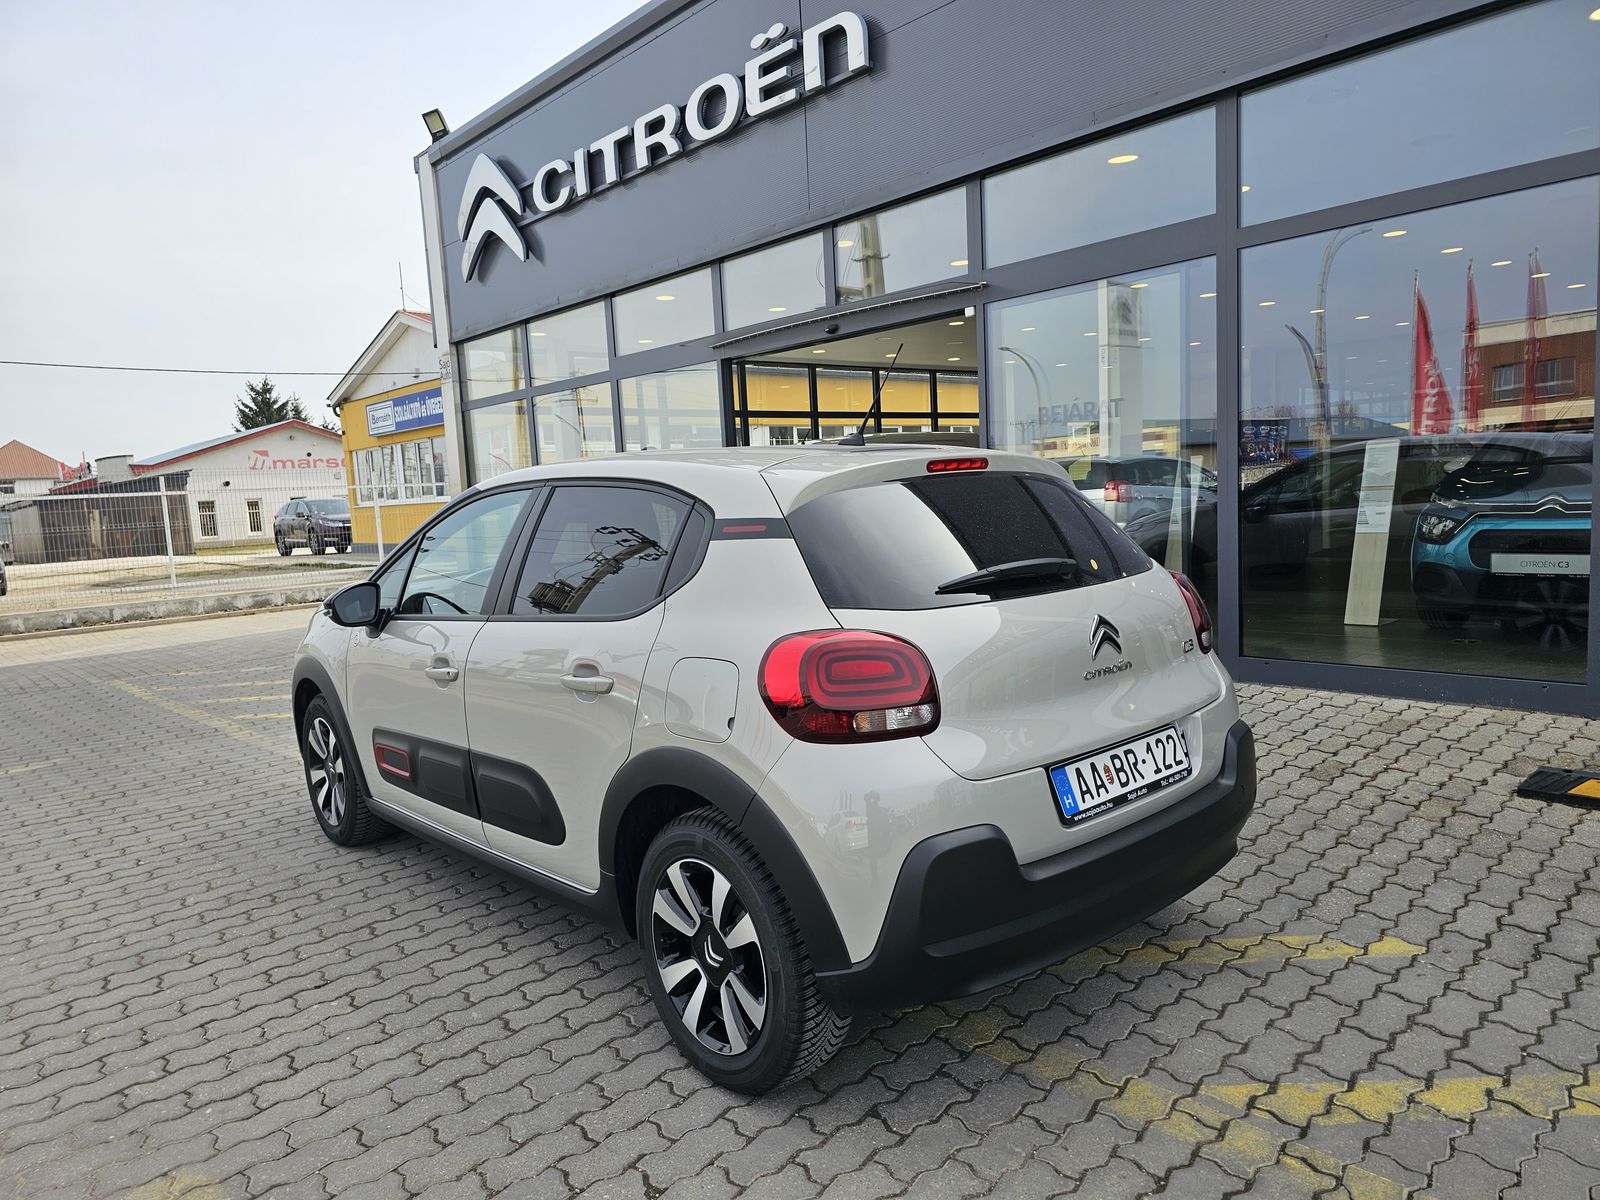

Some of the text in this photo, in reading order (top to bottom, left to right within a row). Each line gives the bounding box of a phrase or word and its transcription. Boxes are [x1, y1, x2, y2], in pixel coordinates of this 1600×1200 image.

[532, 11, 873, 212] CITROËN
[1557, 561, 1570, 569] C3
[1083, 659, 1132, 680] CITROËN
[1063, 794, 1075, 809] H
